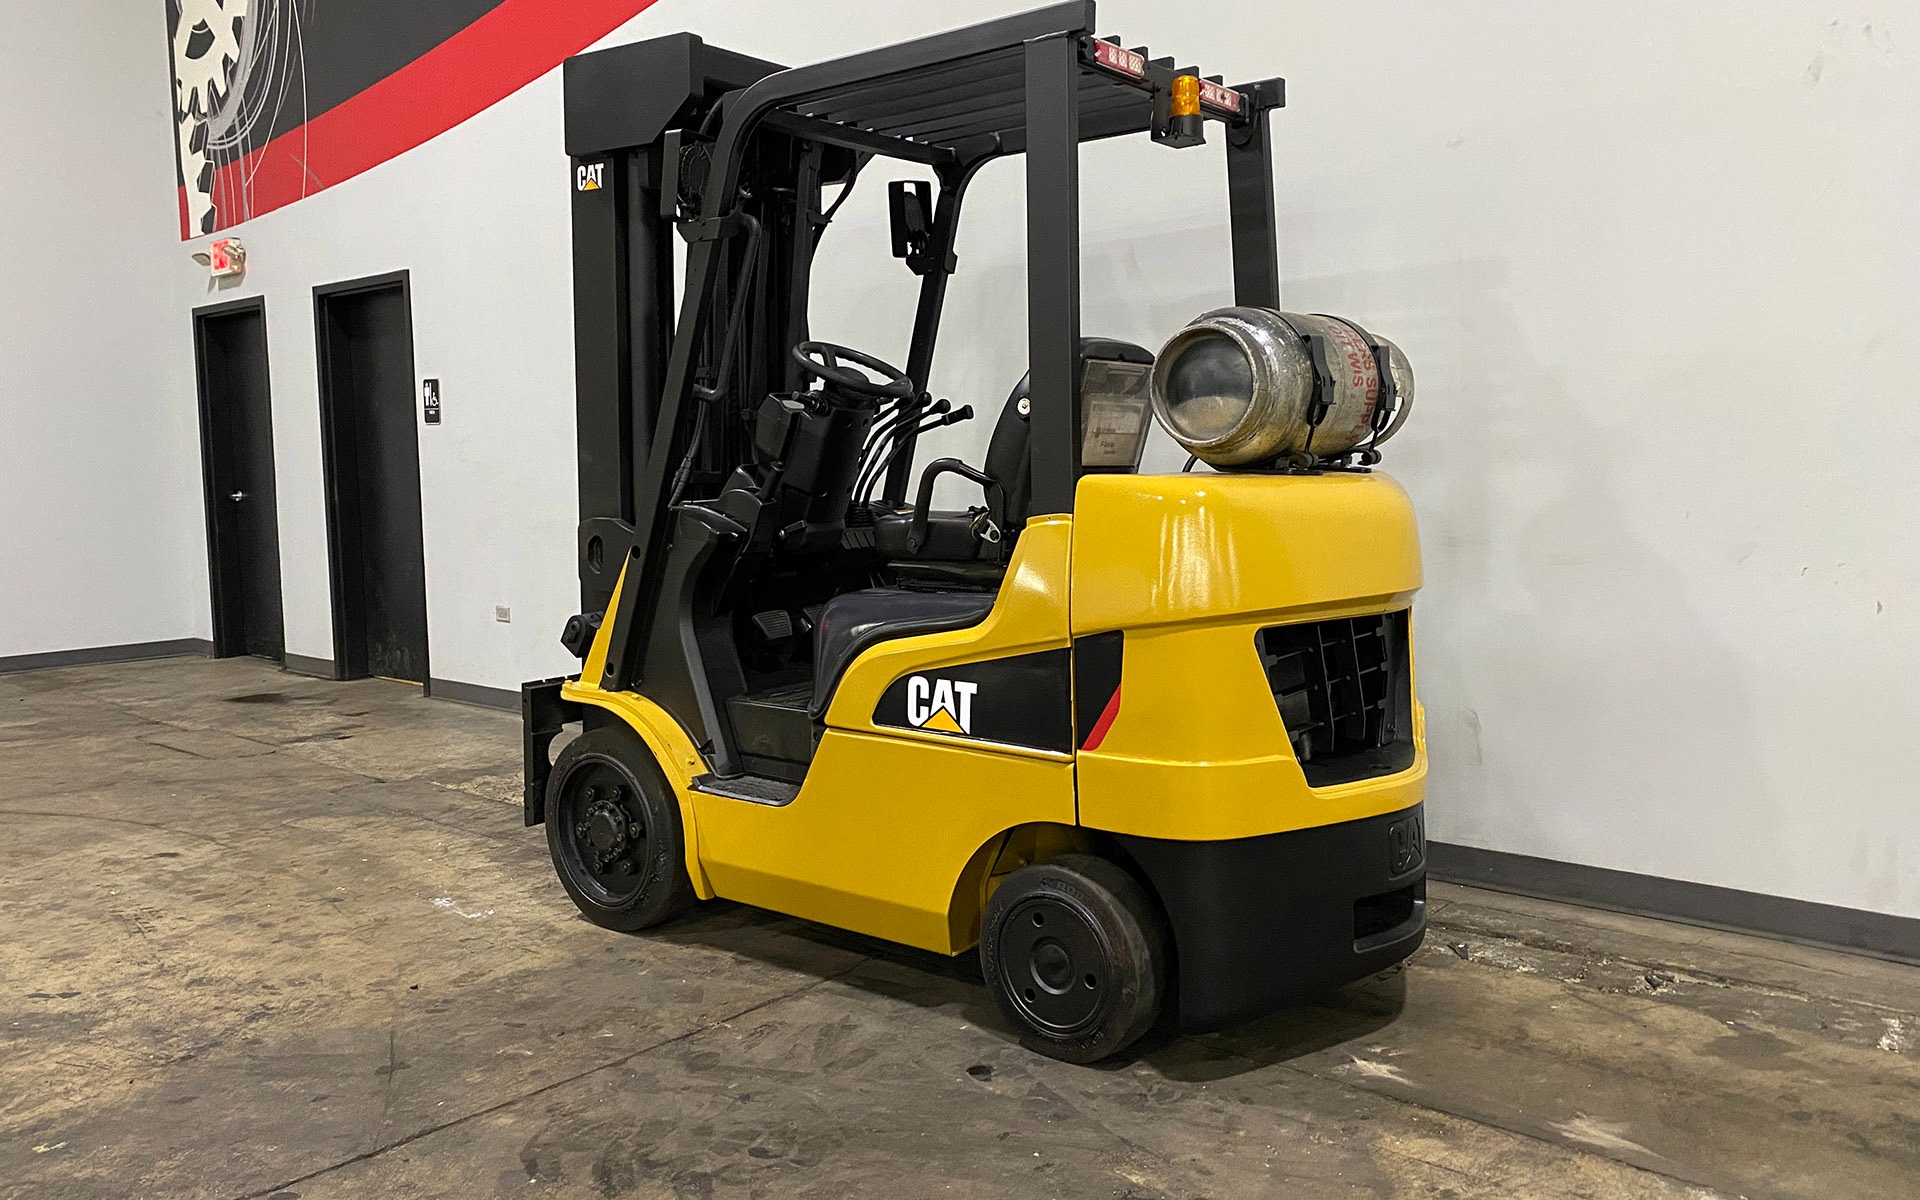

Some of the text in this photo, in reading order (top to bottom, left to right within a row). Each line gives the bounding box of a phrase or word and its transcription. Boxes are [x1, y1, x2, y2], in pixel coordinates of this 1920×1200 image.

[577, 162, 605, 192] CAT
[1348, 352, 1363, 387] WIS
[907, 675, 978, 735] CAT
